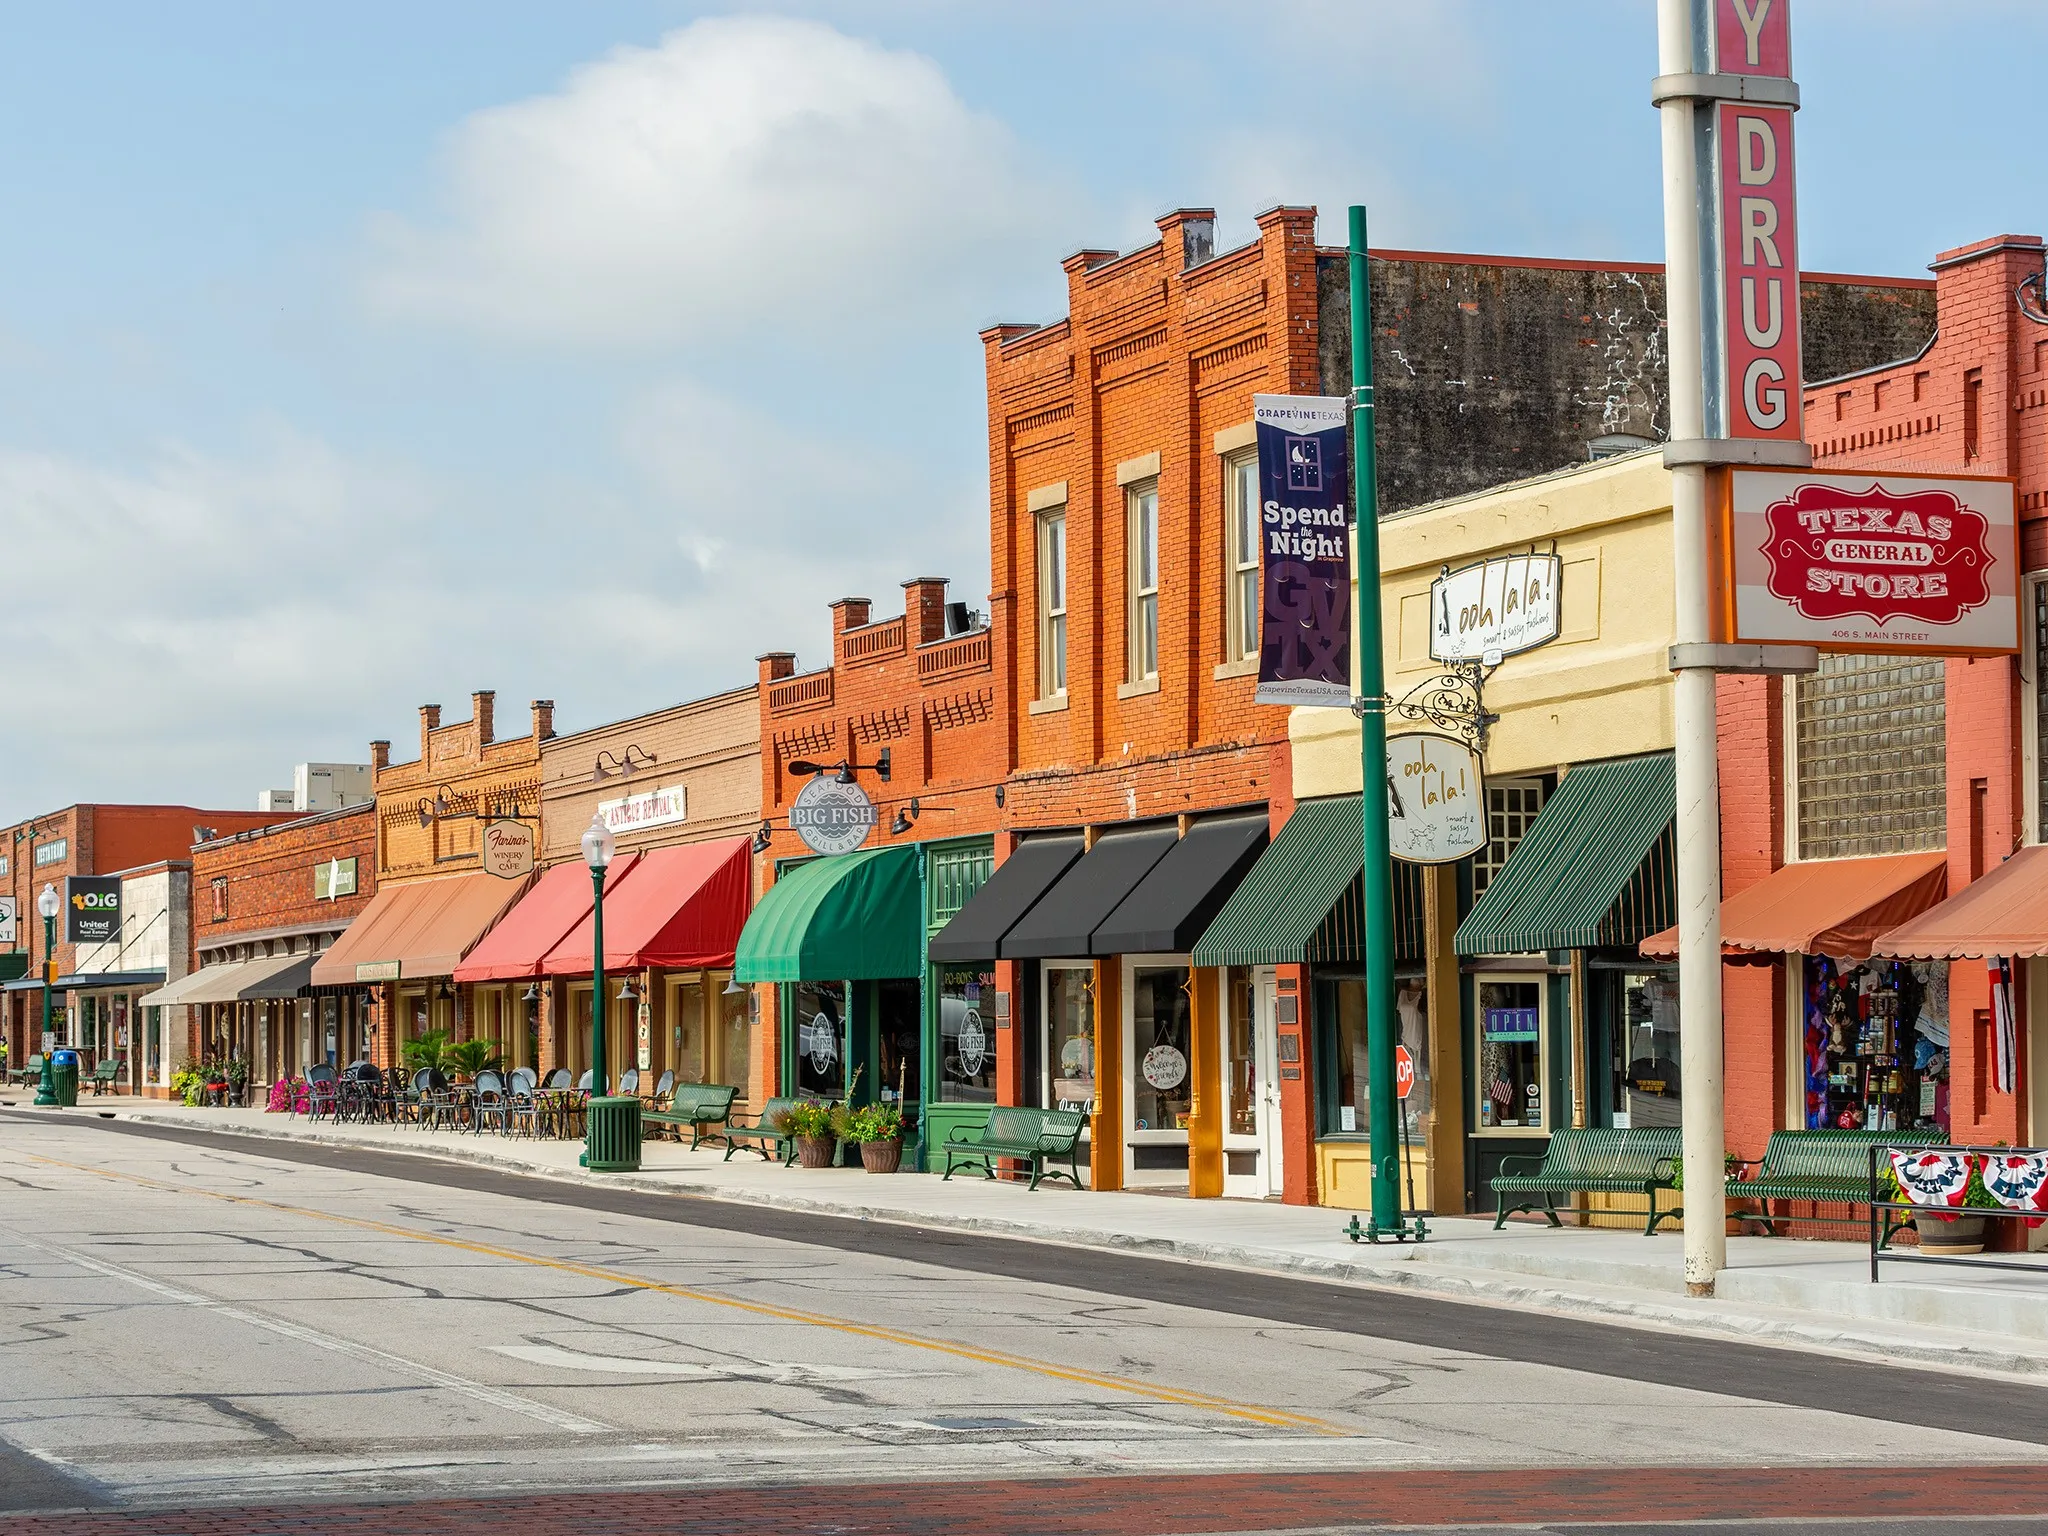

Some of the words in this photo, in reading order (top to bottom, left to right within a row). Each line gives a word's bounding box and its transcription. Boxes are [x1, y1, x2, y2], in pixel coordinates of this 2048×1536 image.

[1736, 115, 1788, 431] DRUG
[1264, 500, 1345, 530] Spend
[1798, 507, 1952, 540] TEXAS
[1300, 526, 1313, 538] the
[1270, 531, 1344, 562] Night
[1831, 544, 1928, 562] GENERAL
[1806, 567, 1949, 599] STORE
[1460, 558, 1493, 634] ooh
[1483, 624, 1502, 647] smart
[1508, 621, 1525, 644] sassy
[1525, 608, 1549, 632] fashions
[1832, 630, 1849, 639] 406
[1853, 631, 1862, 639] S.
[1865, 631, 1889, 640] MAIN
[1892, 632, 1930, 641] STREET
[1258, 685, 1349, 697] GrapevineTexasUSA.com
[1404, 740, 1437, 777] ooh
[804, 781, 863, 805] SEAFOOD
[609, 802, 640, 826] ANTIQUE
[642, 796, 672, 820] REVIVAL
[794, 808, 827, 825] BIG
[831, 807, 873, 824] FISH
[1446, 812, 1468, 822] smart
[488, 829, 530, 850] Farina's
[805, 828, 833, 851] GRILL
[847, 827, 864, 846] BAR
[1447, 834, 1474, 846] fashions
[1449, 824, 1469, 838] sassy
[493, 851, 525, 860] WINERY
[498, 862, 521, 871] CAFE
[1491, 1013, 1533, 1032] OPEN
[960, 1037, 970, 1049] BIG
[971, 1037, 984, 1049] FISH
[1397, 1060, 1413, 1083] OP
